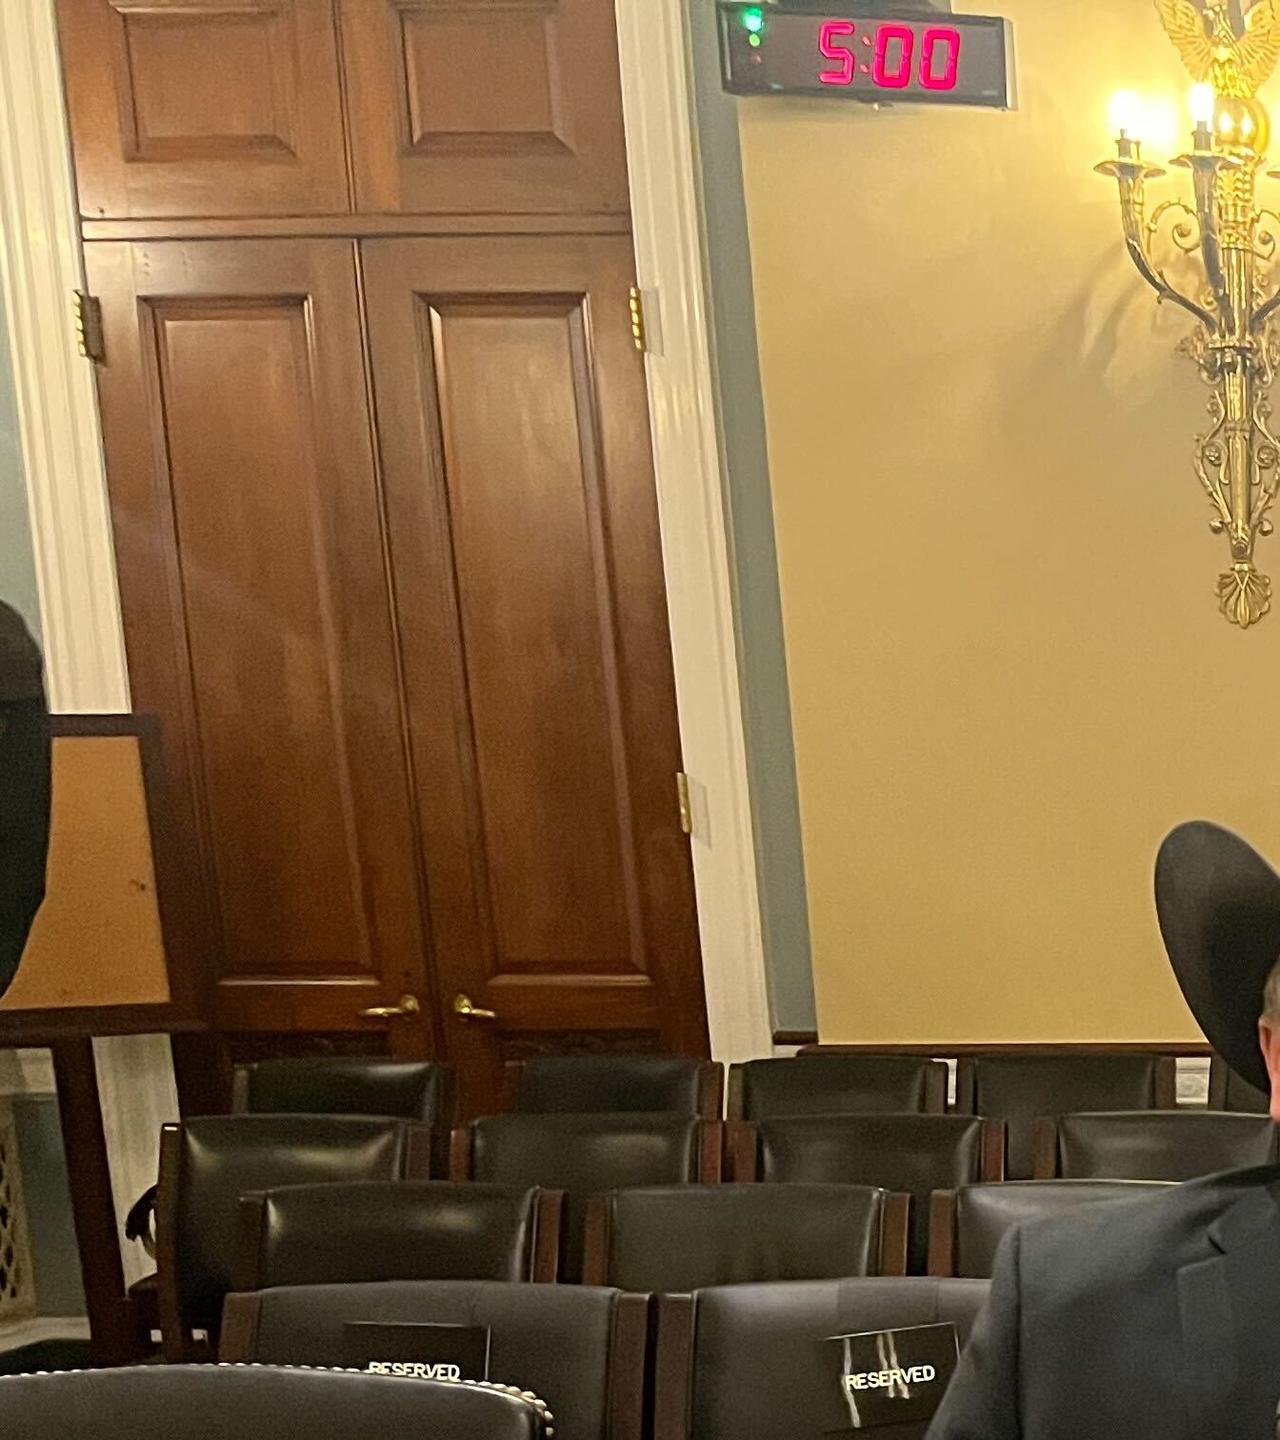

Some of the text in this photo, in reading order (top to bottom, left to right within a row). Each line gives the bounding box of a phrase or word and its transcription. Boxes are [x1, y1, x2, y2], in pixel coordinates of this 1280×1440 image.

[818, 21, 961, 90] 5:00
[368, 1361, 461, 1383] RESERVED
[845, 1364, 936, 1391] RESERVED
